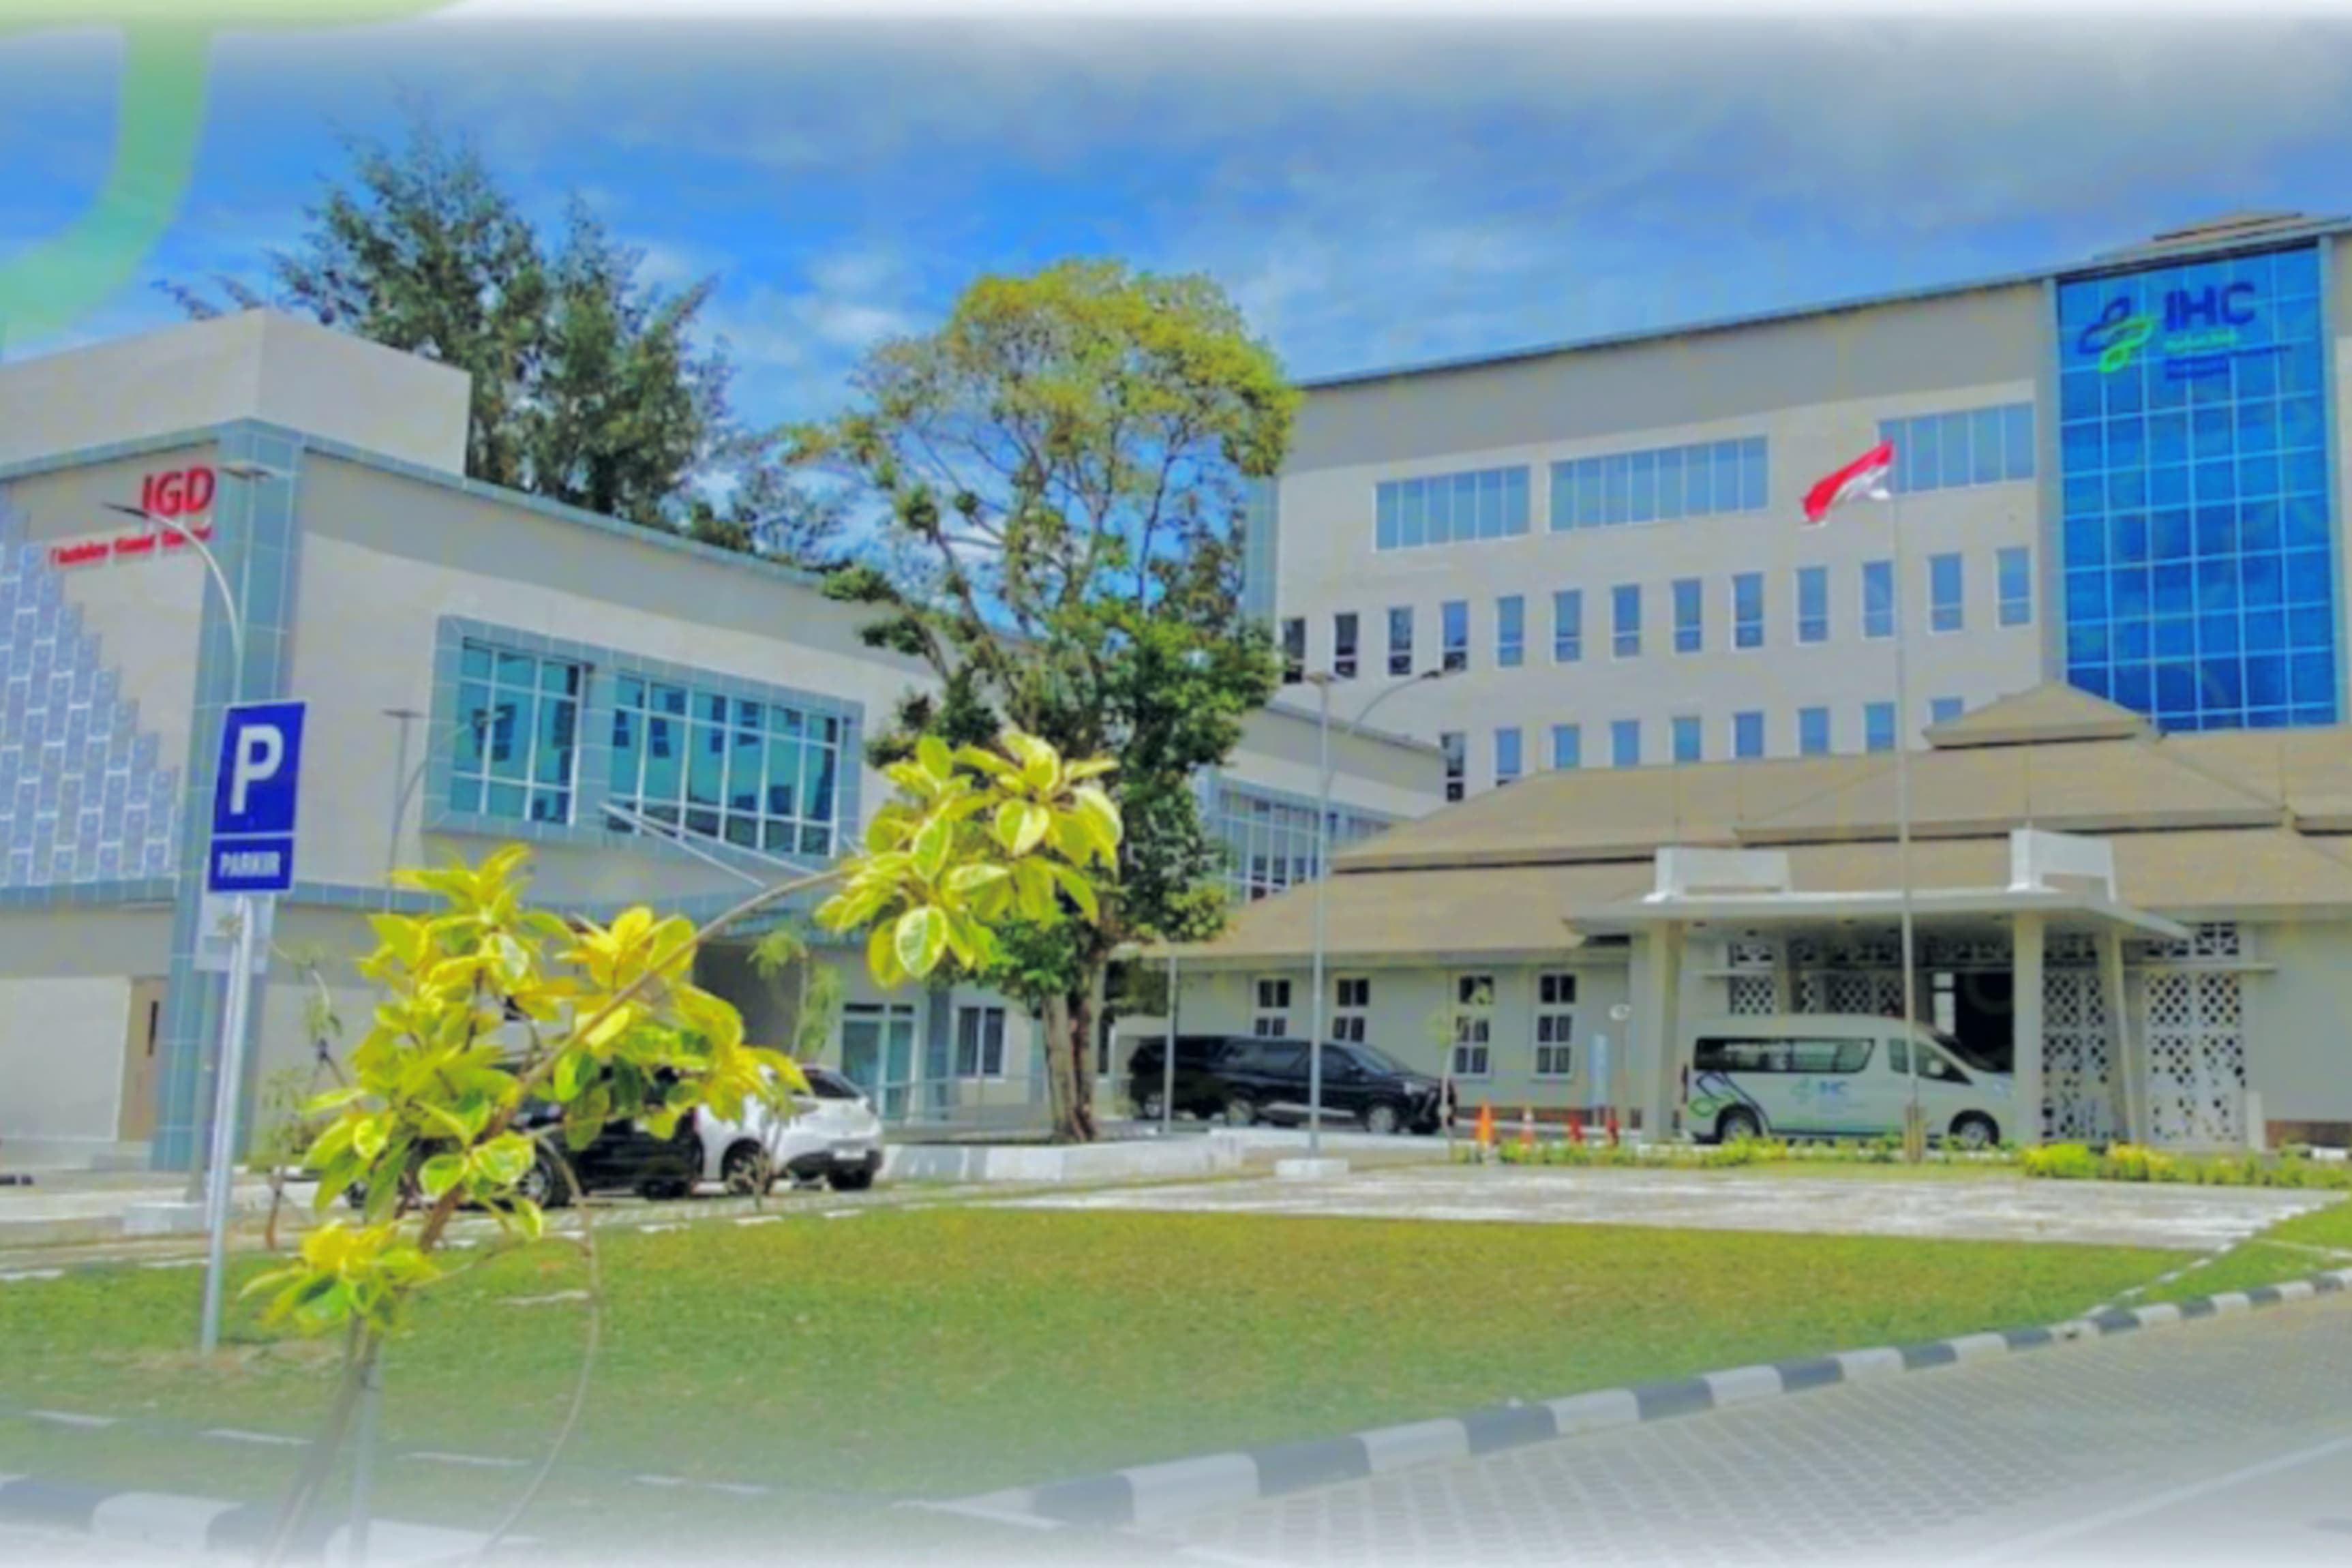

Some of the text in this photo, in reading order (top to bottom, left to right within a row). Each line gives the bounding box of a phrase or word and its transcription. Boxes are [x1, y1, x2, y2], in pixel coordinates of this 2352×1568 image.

[2165, 282, 2255, 331] IHC
[142, 466, 215, 516] IGD
[230, 724, 284, 815] P
[219, 851, 280, 878] PARKIR
